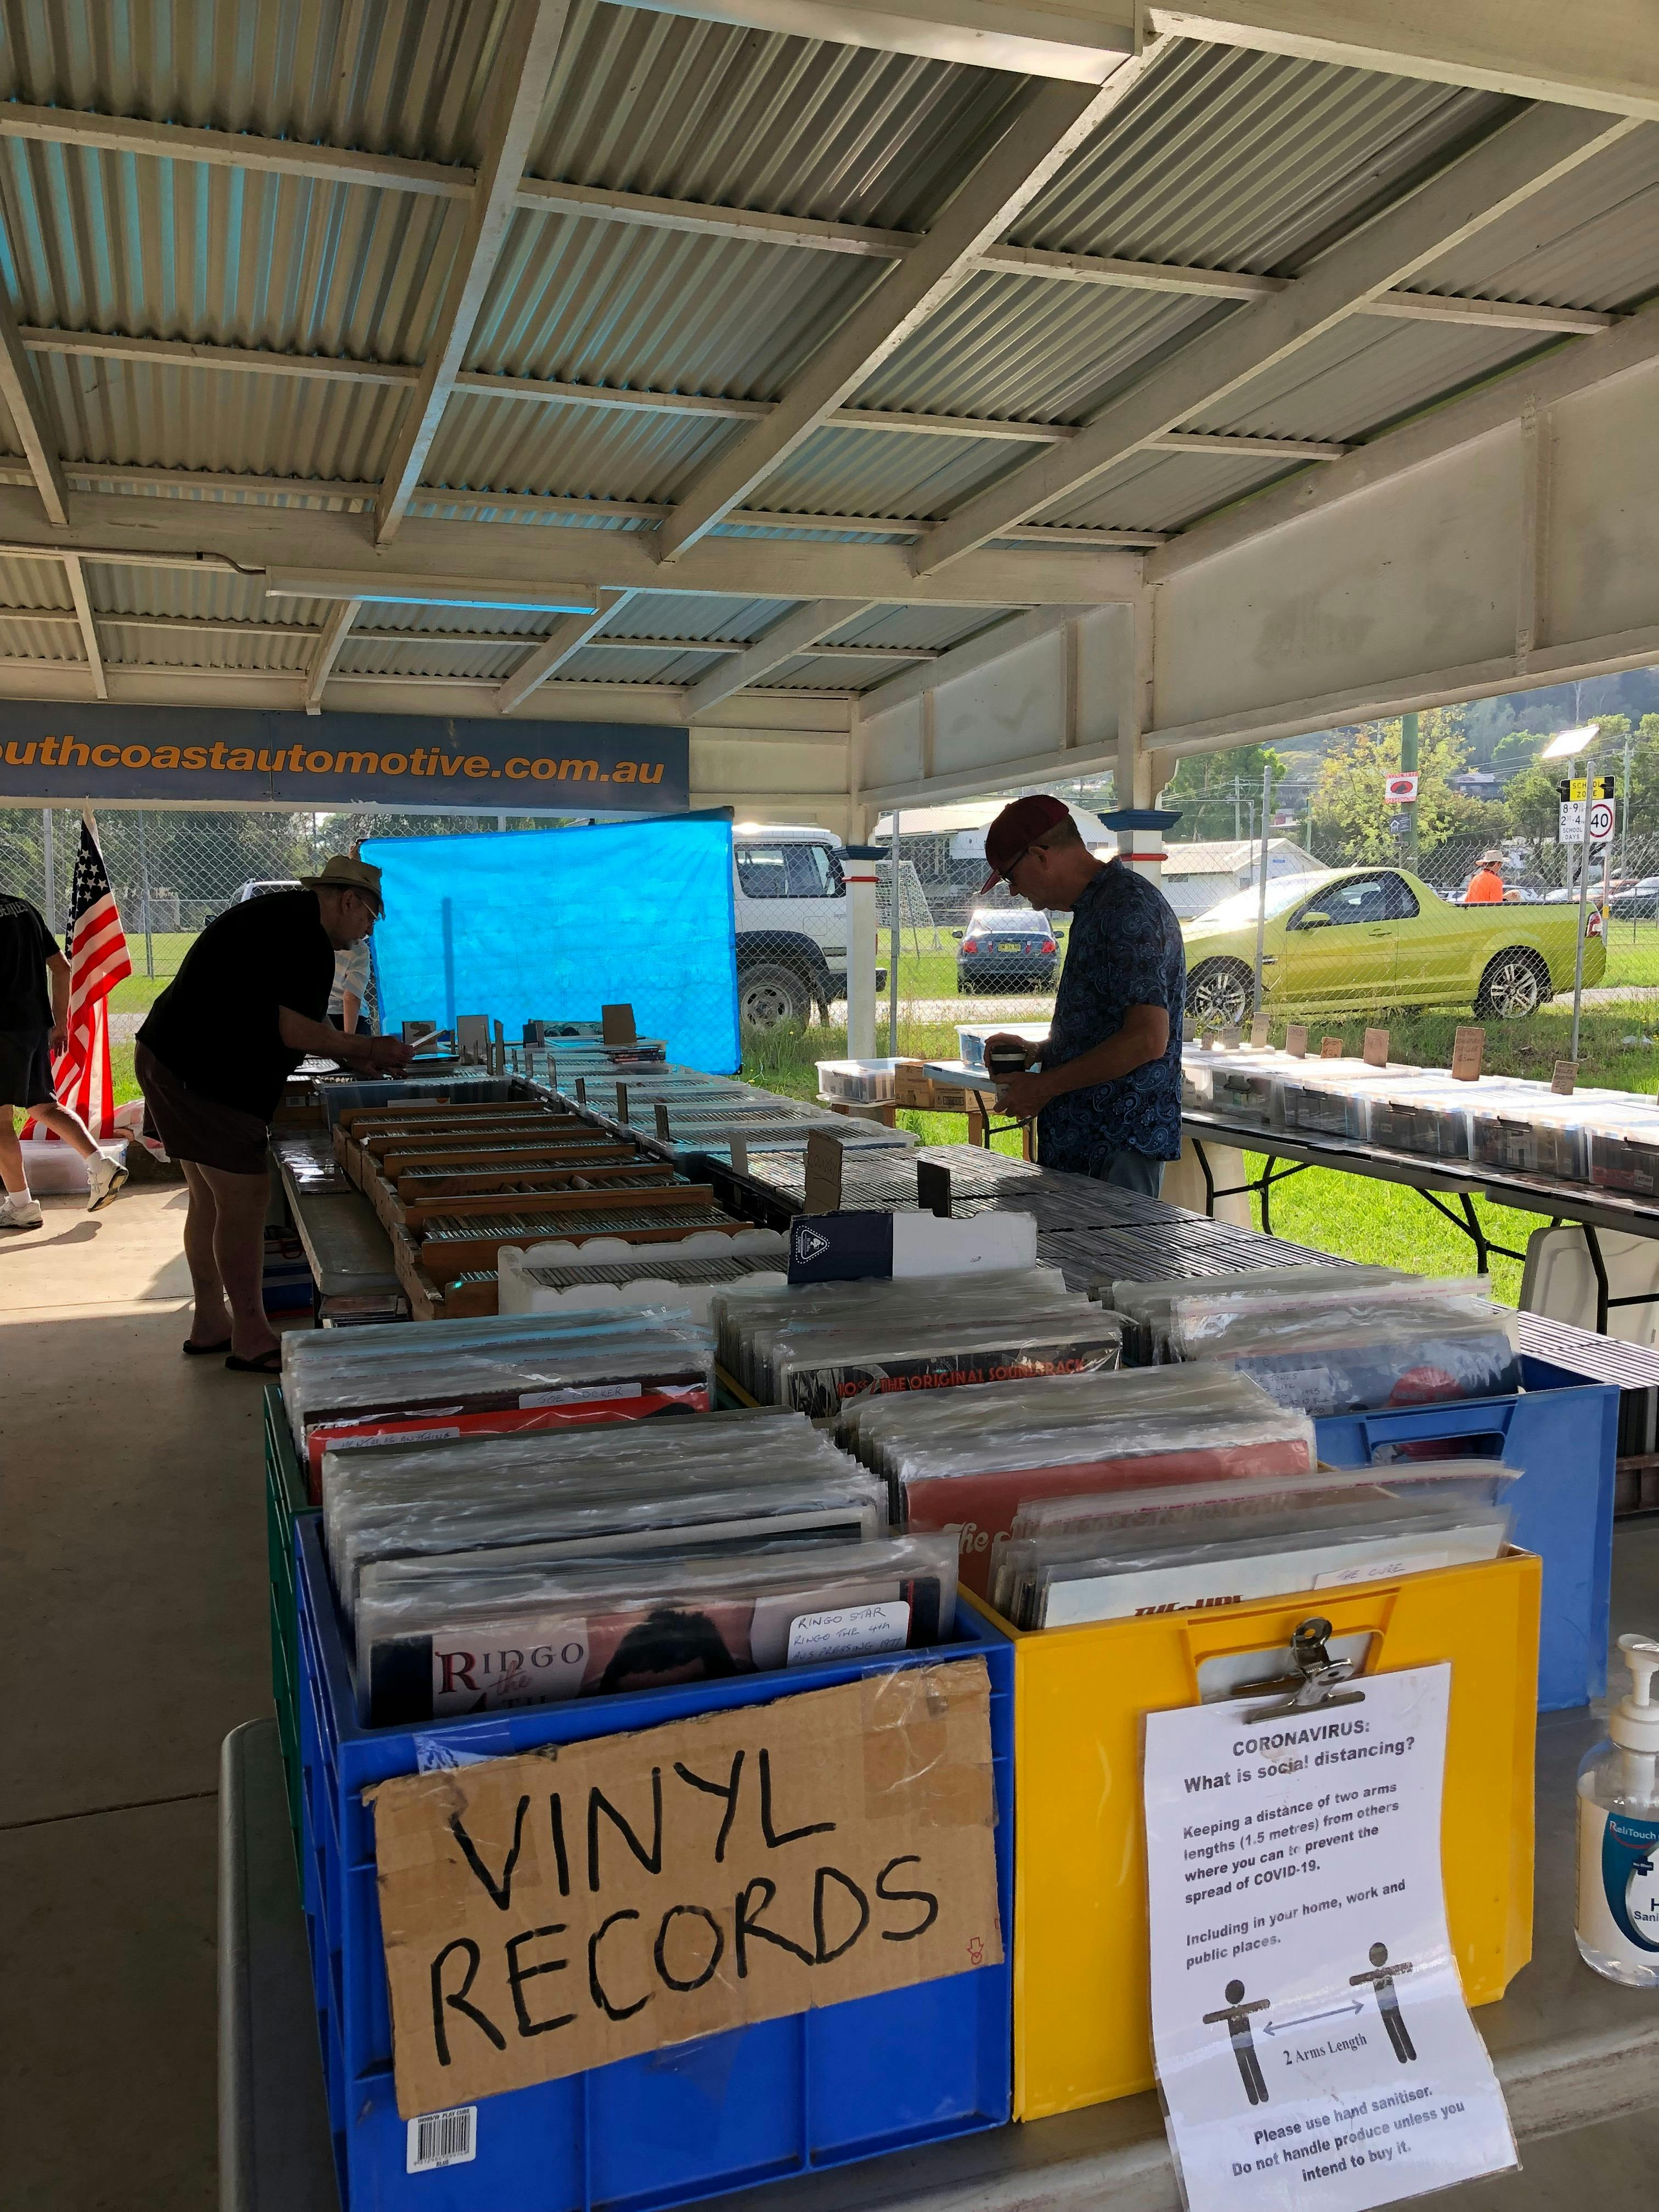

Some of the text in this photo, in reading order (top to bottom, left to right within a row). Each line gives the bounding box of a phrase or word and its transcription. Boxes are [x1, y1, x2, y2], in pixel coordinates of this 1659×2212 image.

[0, 735, 665, 785] uthcoastautomotive.com.au
[1572, 781, 1600, 789] SCHOL
[1590, 813, 1609, 828] 40
[538, 1386, 624, 1404] JOE COCKER
[837, 1379, 868, 1398] 10cc
[880, 1376, 907, 1393] THE
[910, 1368, 985, 1391] ORIGINAL
[989, 1359, 1085, 1382] SOUNDTRACK
[943, 1521, 989, 1554] The
[1336, 1563, 1406, 1582] THE CURE
[794, 1633, 831, 1646] RINGO
[836, 1627, 860, 1638] THE
[797, 1606, 886, 1630] RINGO STAR
[435, 1642, 584, 1695] RINGO
[793, 1650, 814, 1661] AUS
[880, 1637, 902, 1649] 1977
[489, 1660, 533, 1696] the
[1232, 1719, 1370, 1757] CORONAVIRUS:
[1184, 1736, 1415, 1793] What is social distancing?
[449, 1748, 837, 1910] VINYL
[1183, 1782, 1397, 1839] Keeping a distance of two arms
[1183, 1801, 1400, 1861] lengths (1.5 metres) from others
[1610, 1821, 1656, 1840] ReliTouch
[1185, 1863, 1228, 1883] where
[1232, 1857, 1256, 1875] you
[1260, 1849, 1284, 1864] can
[1305, 1833, 1355, 1854] prevent
[1358, 1825, 1379, 1838] the
[1185, 1860, 1321, 1904] spread of COVID-19.
[1186, 1880, 1406, 1946] Including in your home, work and
[430, 1854, 940, 2066] RECORDS
[1186, 1936, 1281, 1970] public places.
[1283, 2033, 1367, 2066] 2 Arms Length
[1254, 2085, 1433, 2145] Please use hand sanitiser.
[1232, 2101, 1465, 2177] Do not handle produce unless you
[1302, 2140, 1412, 2182] intend to buy it.
